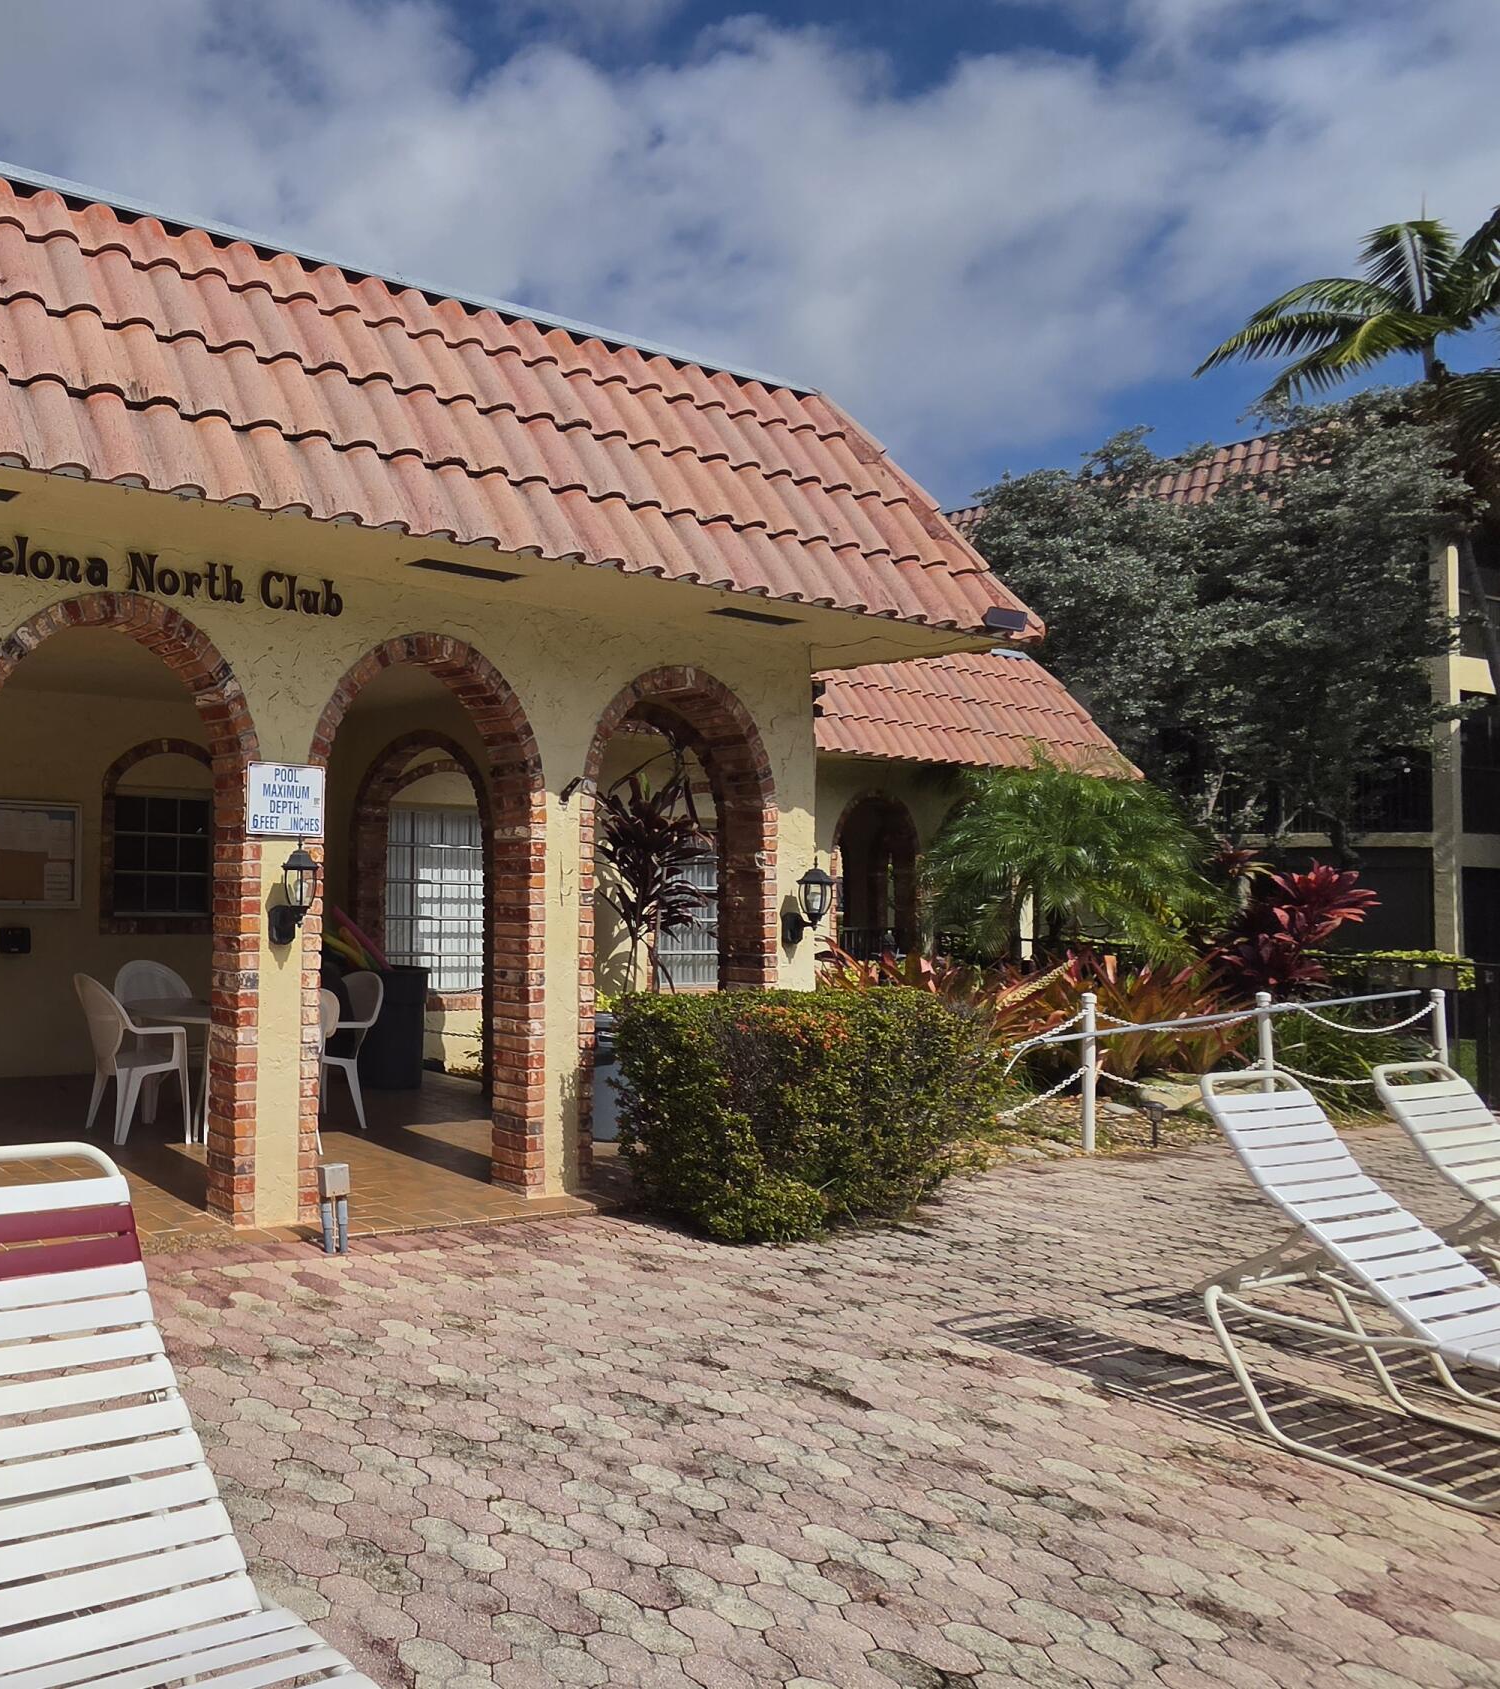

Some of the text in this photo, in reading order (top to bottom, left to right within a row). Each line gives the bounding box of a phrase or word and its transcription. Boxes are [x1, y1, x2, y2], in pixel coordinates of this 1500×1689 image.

[128, 551, 245, 604] North
[260, 570, 344, 618] Club
[274, 767, 299, 783] POOL
[263, 783, 309, 799] MAXIMUM
[269, 799, 303, 815] DEPTH:
[252, 814, 319, 832] 6 FEET INCHES
